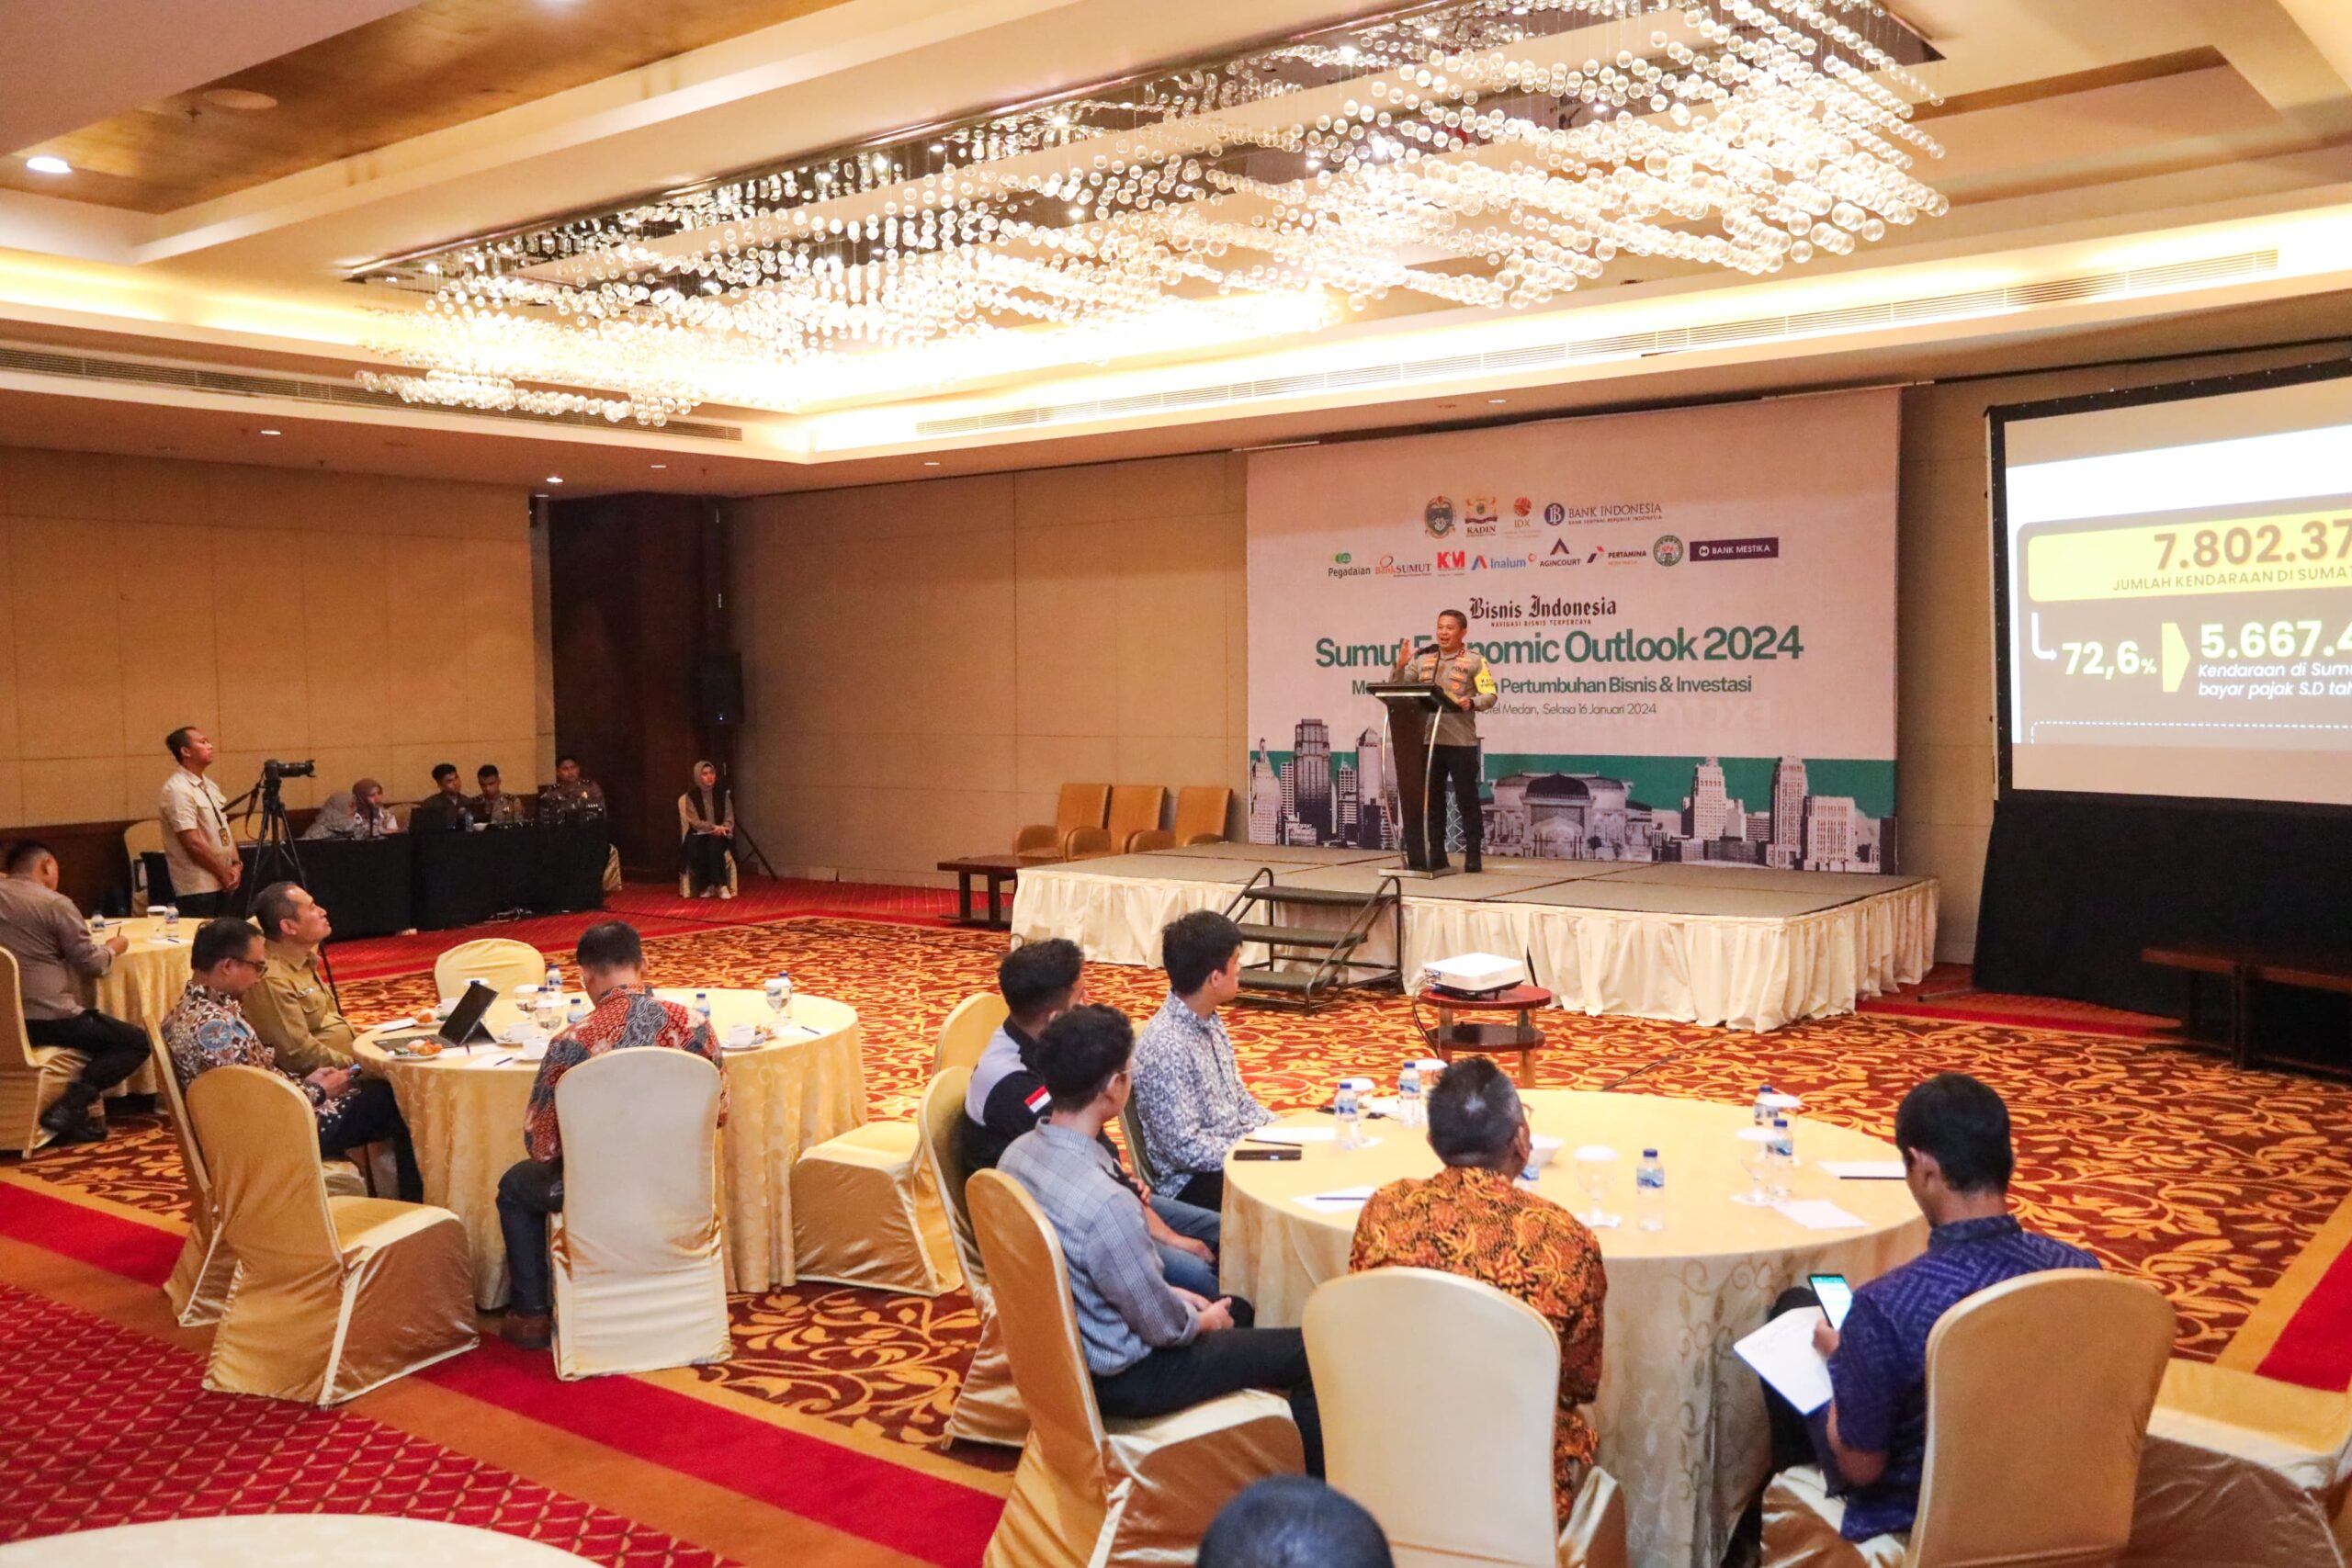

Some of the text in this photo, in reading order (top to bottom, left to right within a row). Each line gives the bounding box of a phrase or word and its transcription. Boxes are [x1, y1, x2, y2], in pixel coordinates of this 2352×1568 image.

[1568, 503, 1661, 518] BANK INDONESIA
[1467, 525, 1496, 535] KADIN
[1514, 519, 1530, 528] IDX
[1712, 544, 1770, 555] BANK MESTIKA
[2154, 518, 2352, 570] 7.802.37
[1608, 550, 1646, 558] PERTAMINA
[1490, 557, 1526, 570] Inalum
[1540, 558, 1581, 567] AGINCOURT
[1329, 566, 1371, 579] Pegadaian
[2113, 577, 2171, 591] JUMLAH
[2176, 571, 2273, 588] KENDARAAN
[2278, 569, 2293, 582] DI
[1470, 594, 1617, 619] Bisnis Indonesia
[1565, 627, 1699, 662] Outlook
[1703, 626, 1804, 660] 2024
[2062, 640, 2157, 681] 72,6%
[2198, 663, 2285, 678] Kendaraan
[2290, 661, 2307, 676] di
[1501, 677, 1607, 694] Pertumbuhan
[1610, 676, 1657, 693] Bisnis
[1659, 676, 1674, 693] &
[1677, 675, 1752, 693] Investasi
[2198, 682, 2245, 699] bayar
[2248, 682, 2294, 700] pajak
[2299, 681, 2324, 695] S.D
[1503, 703, 1540, 716] Medan,
[1544, 703, 1576, 715] Selasa
[1578, 703, 1588, 715] 16
[1589, 704, 1624, 716] Januari
[1627, 703, 1657, 715] 2024
